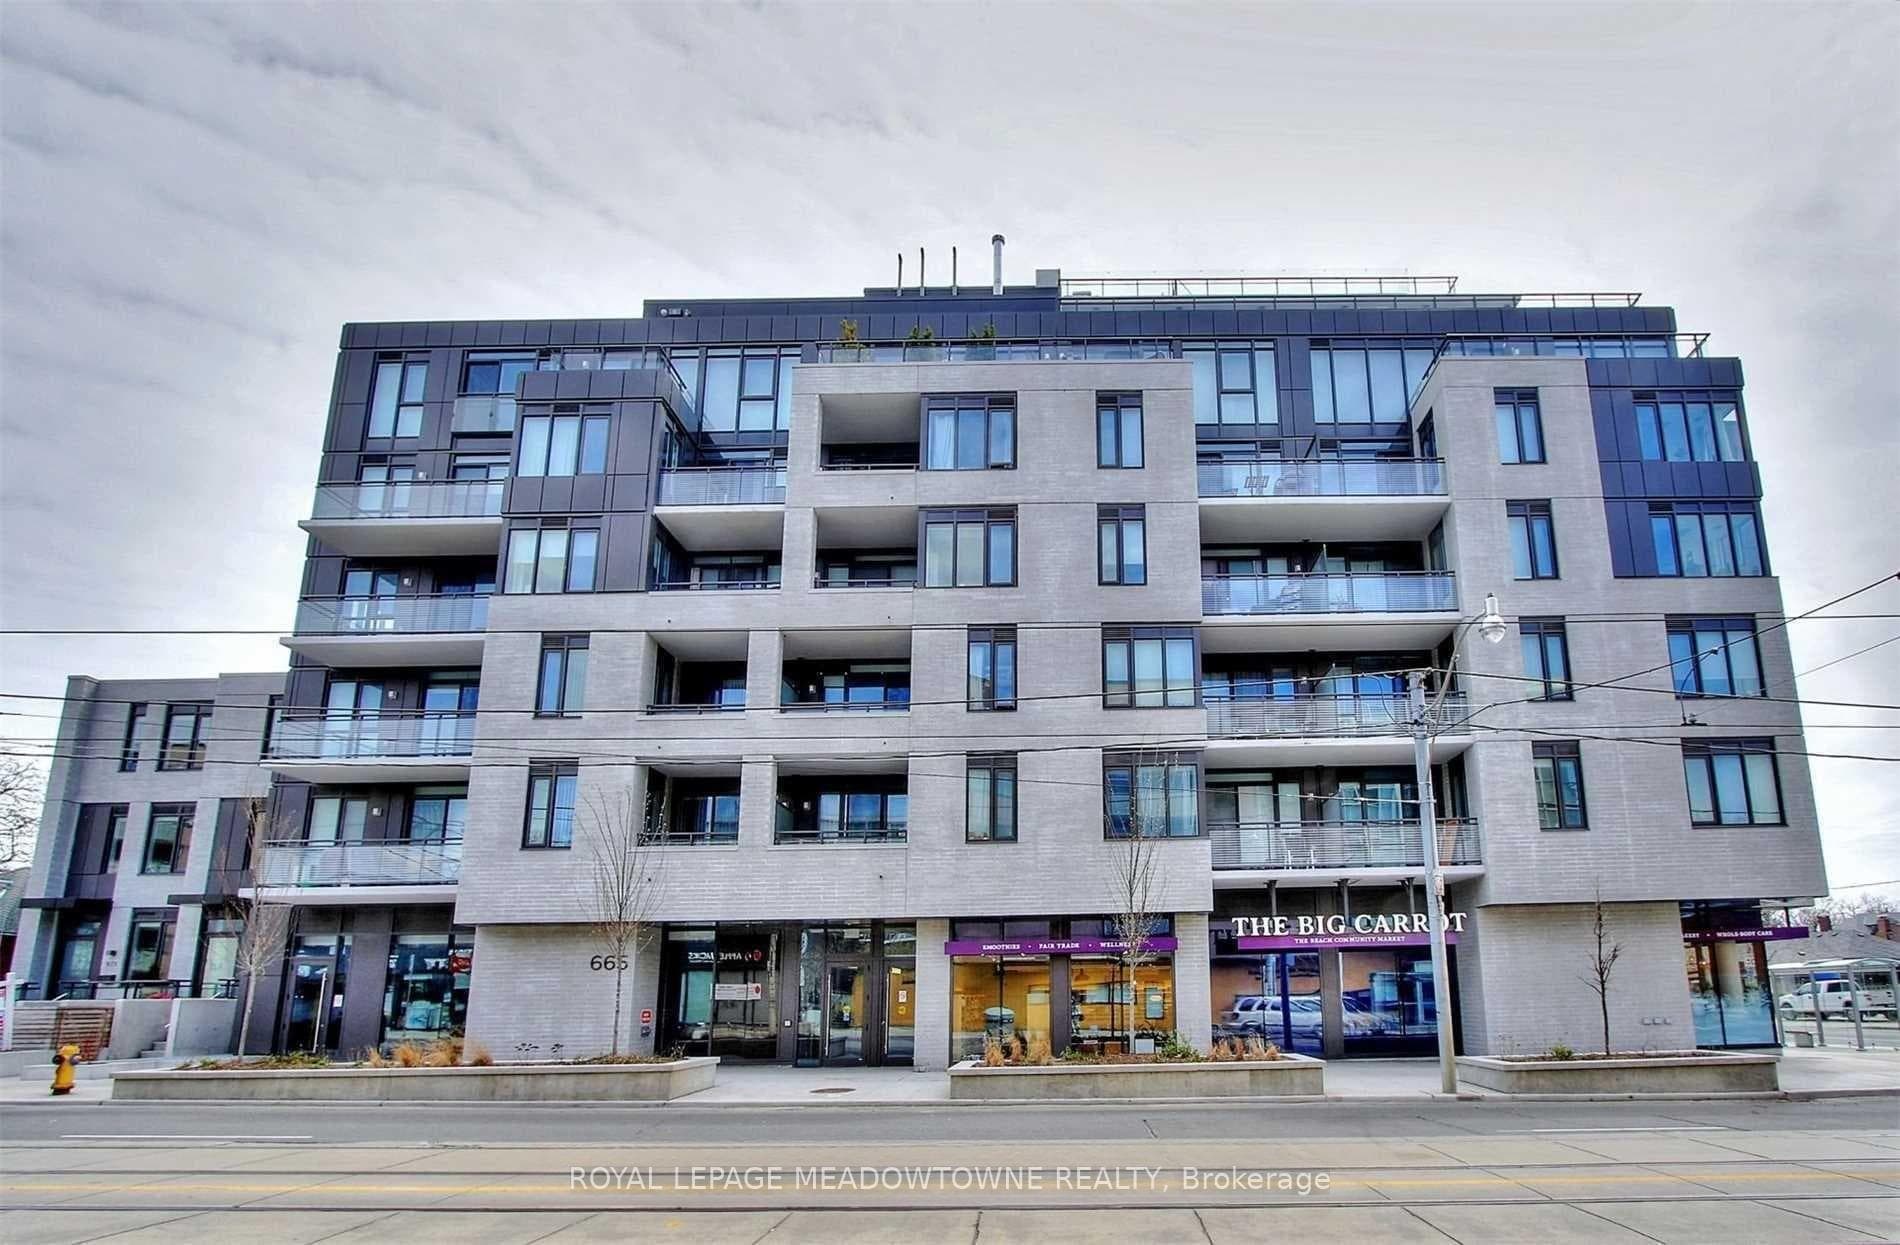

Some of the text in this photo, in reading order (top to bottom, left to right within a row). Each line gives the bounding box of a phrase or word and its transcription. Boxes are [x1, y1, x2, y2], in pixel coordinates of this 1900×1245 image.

[1231, 917, 1289, 937] THE
[1297, 915, 1346, 936] BIG
[590, 955, 629, 971] 665
